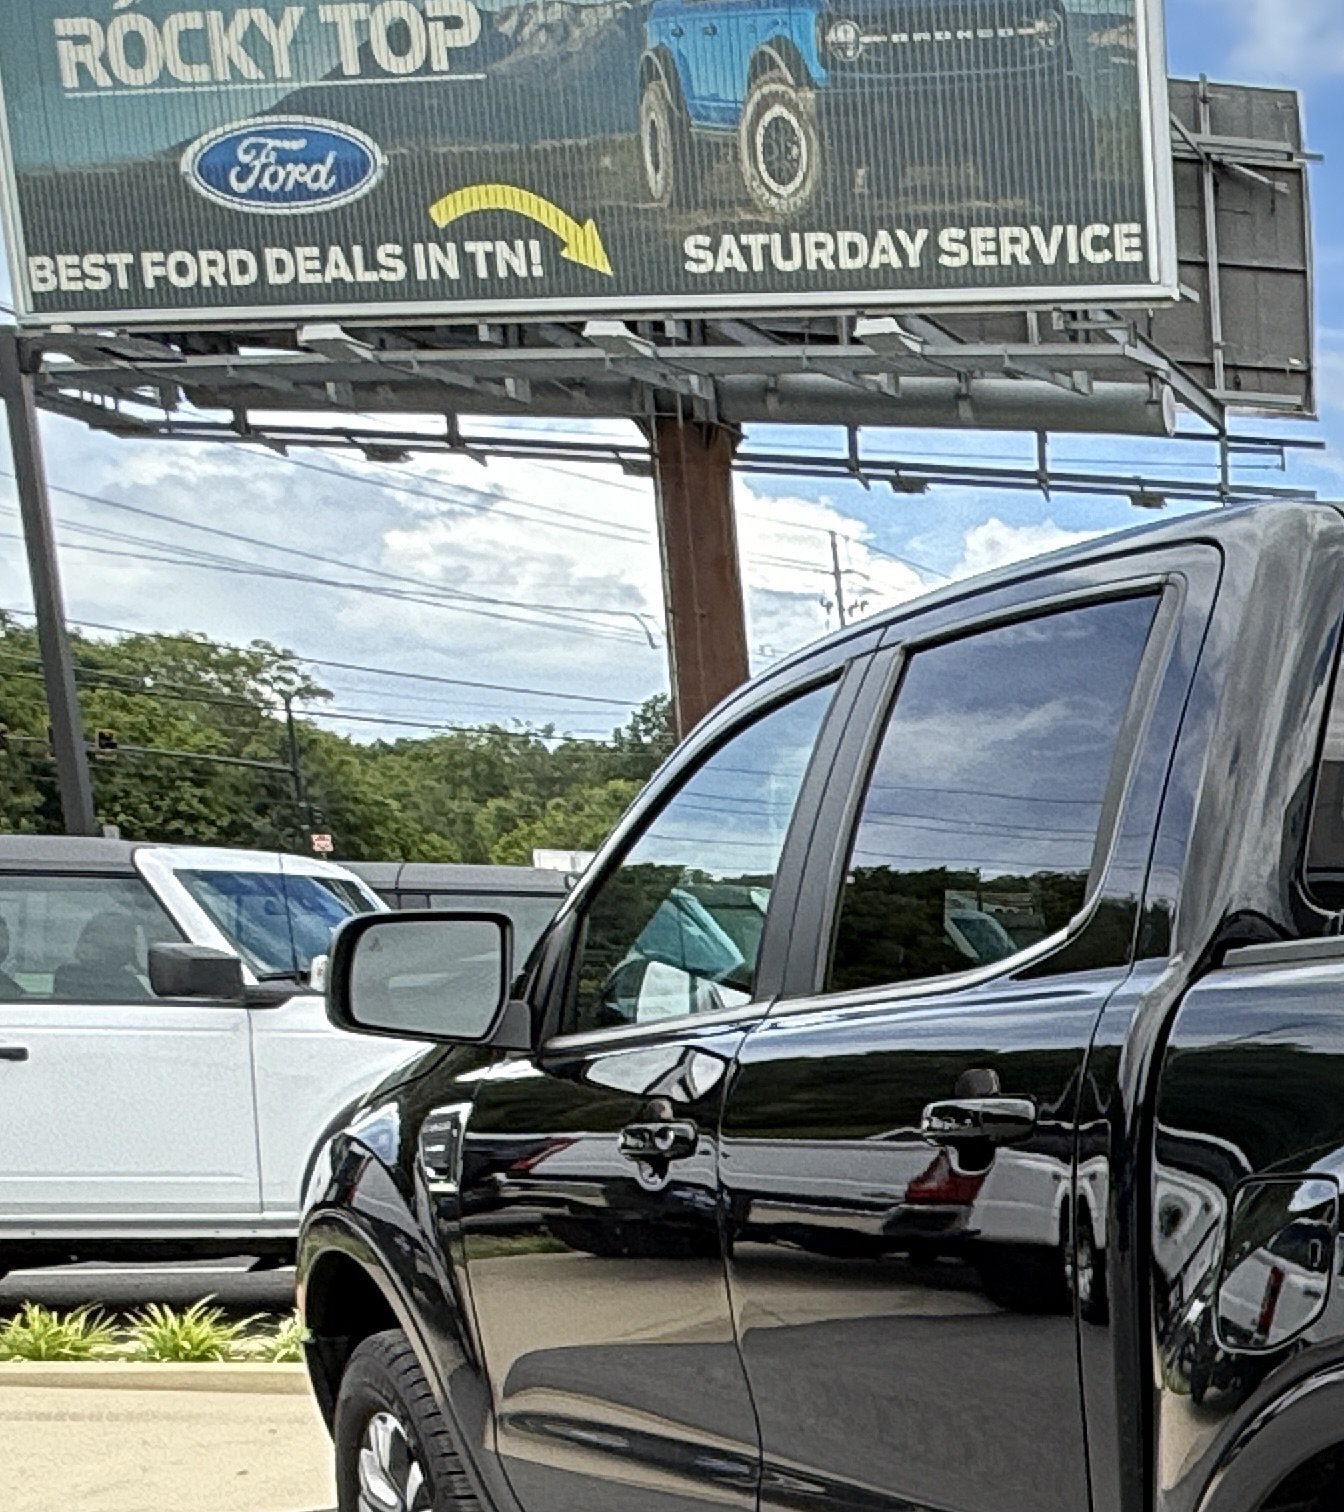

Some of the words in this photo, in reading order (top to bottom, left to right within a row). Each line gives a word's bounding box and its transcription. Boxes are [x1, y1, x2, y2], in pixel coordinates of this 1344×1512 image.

[54, 7, 299, 88] ROCKY
[318, 0, 483, 76] TOP
[228, 135, 338, 194] Ford
[28, 253, 135, 292] BEST
[141, 249, 258, 289] FORD
[264, 242, 407, 285] DEALS
[413, 242, 460, 281] IN
[464, 238, 544, 280] TN!
[684, 228, 929, 274] SATURDAY
[937, 222, 1143, 268] SERVICE
